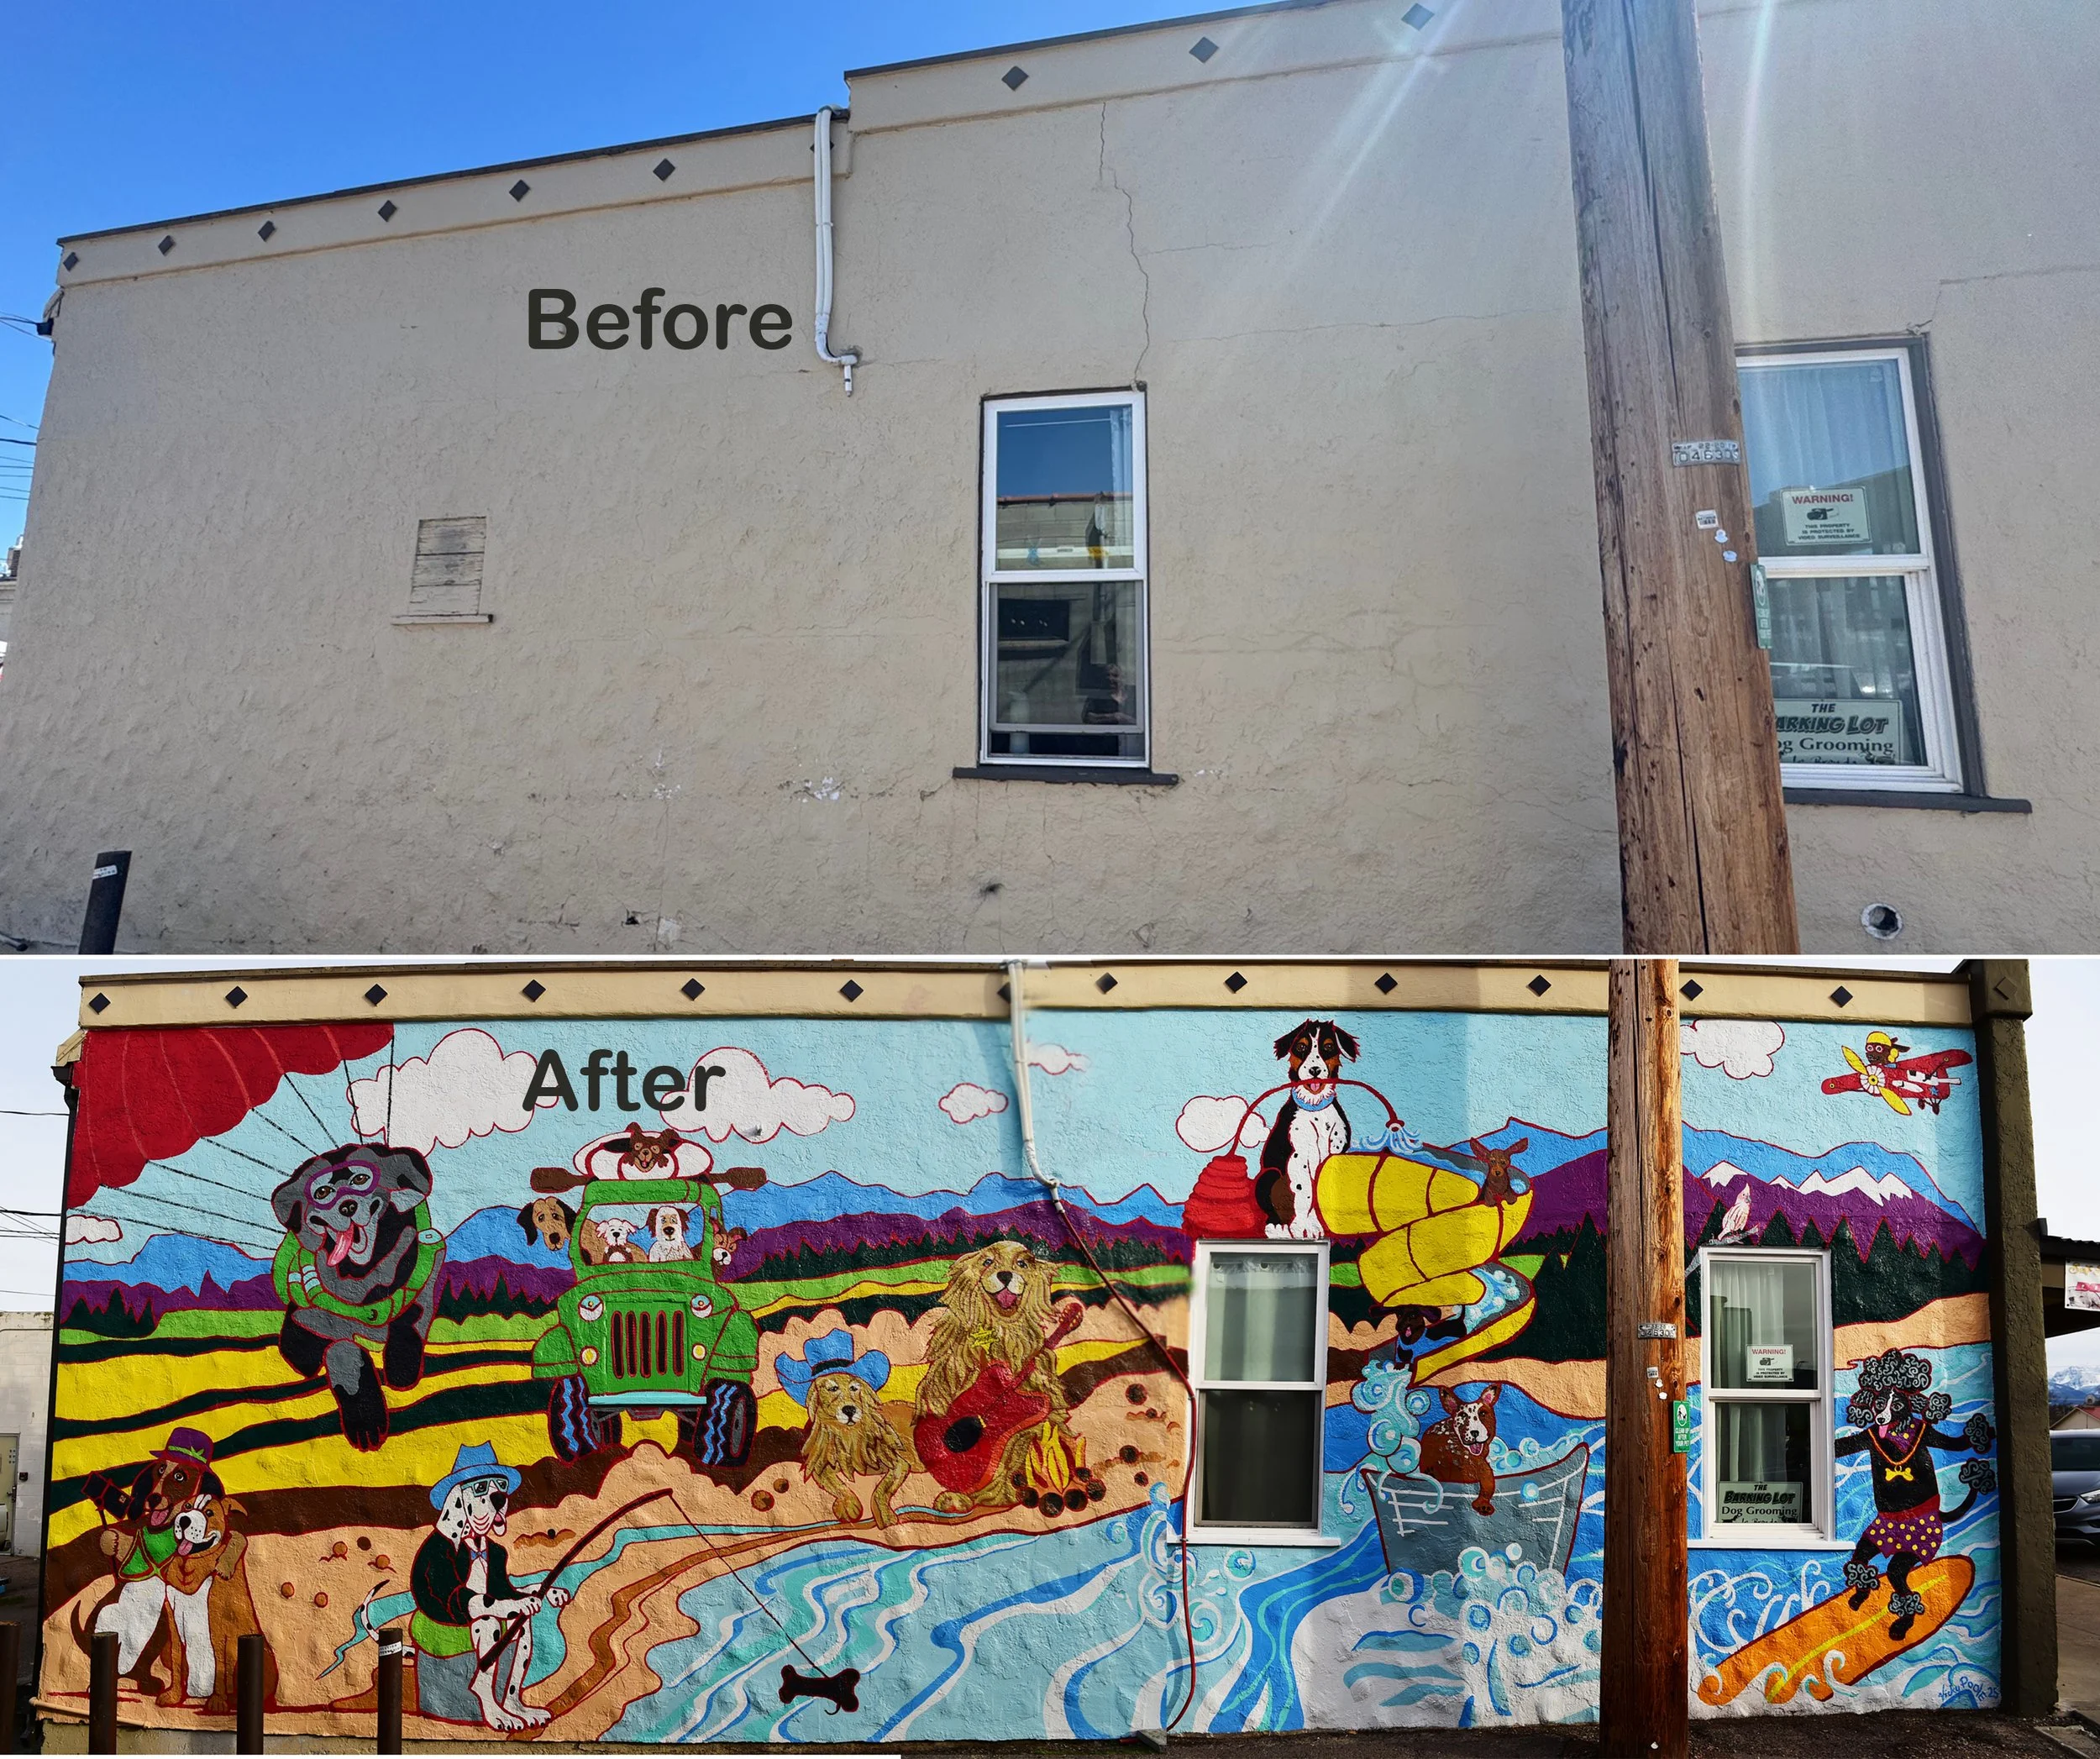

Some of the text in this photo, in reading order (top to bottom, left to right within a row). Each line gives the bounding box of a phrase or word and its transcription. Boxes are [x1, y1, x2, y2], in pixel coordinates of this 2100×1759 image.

[1792, 494, 1854, 504] WARNING!
[1811, 703, 1836, 713] THE
[1775, 715, 1889, 735] ARKING LOT
[1777, 738, 1894, 755] og Grooming
[1724, 1490, 1795, 1504] BARKING LOT
[1722, 1506, 1798, 1518] Dog Grooming
